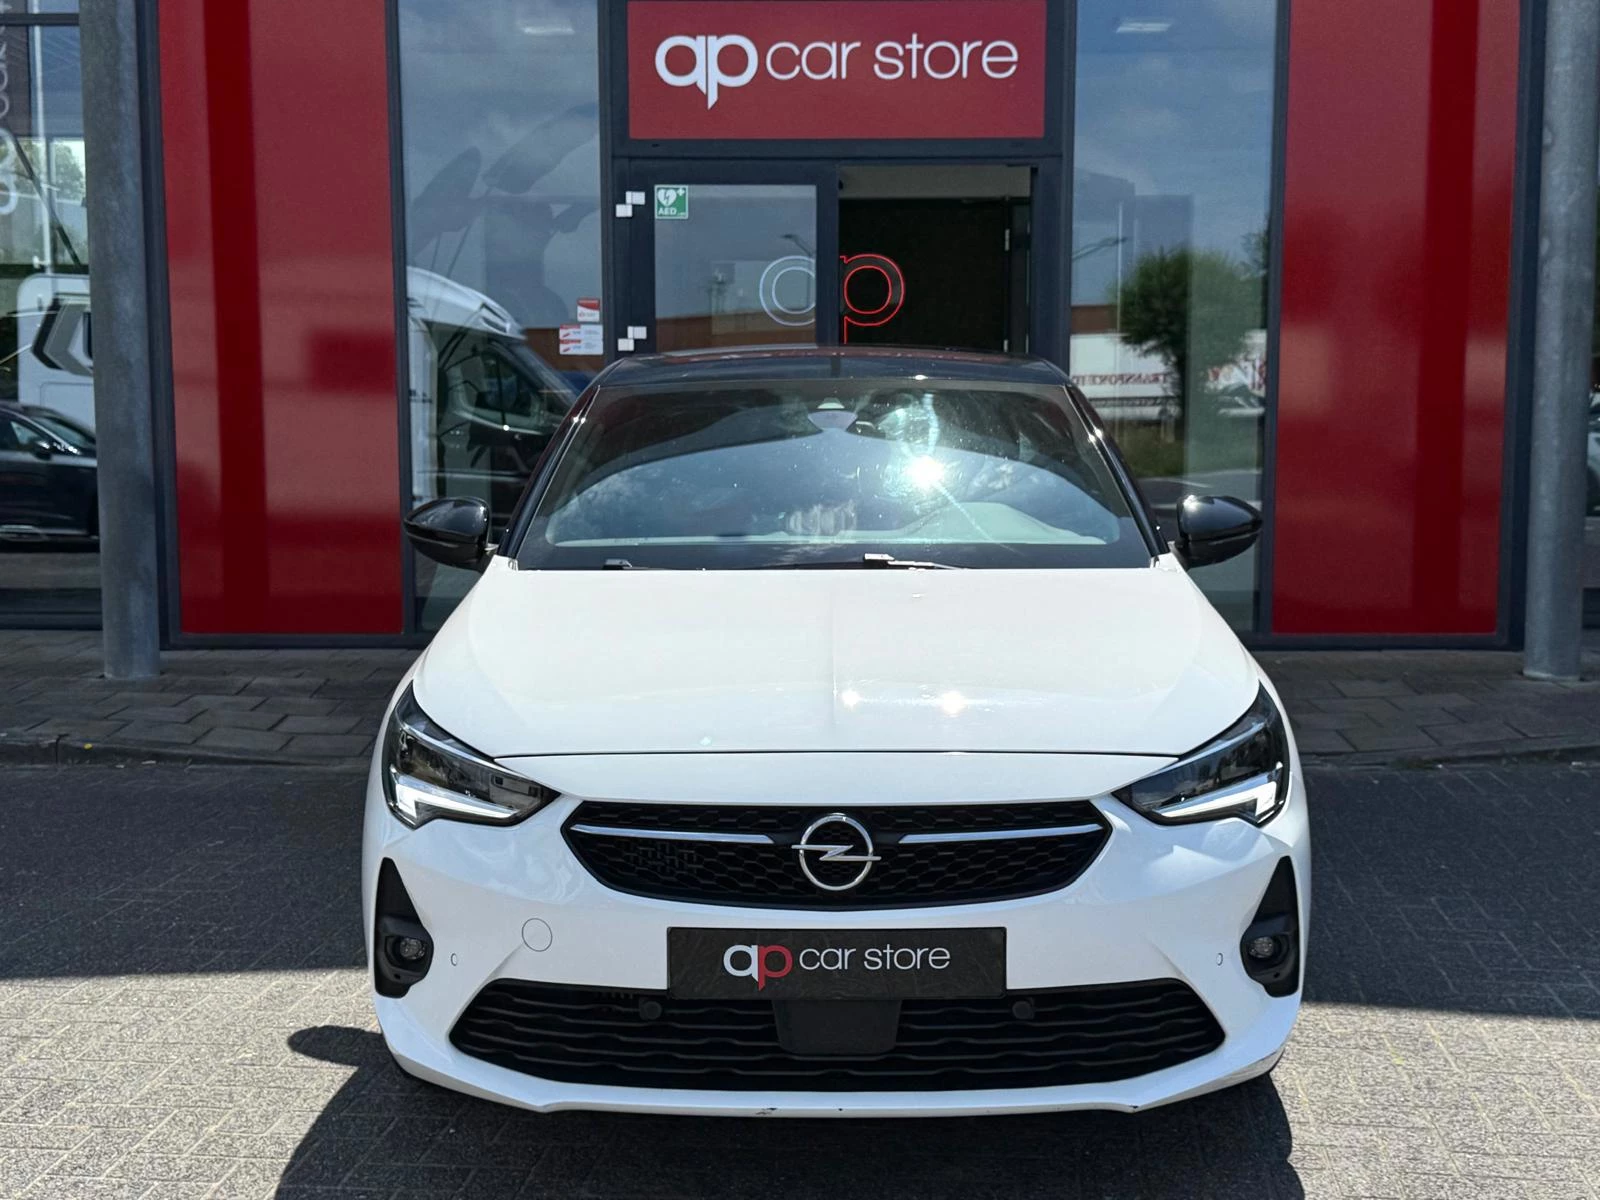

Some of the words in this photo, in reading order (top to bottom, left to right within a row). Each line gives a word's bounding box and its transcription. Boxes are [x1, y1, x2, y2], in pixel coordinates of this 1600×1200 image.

[655, 34, 759, 110] ap
[765, 41, 861, 81] car
[873, 33, 1019, 81] store
[658, 207, 677, 216] AED
[723, 943, 794, 991] ap
[799, 948, 857, 971] car
[863, 943, 951, 971] store
